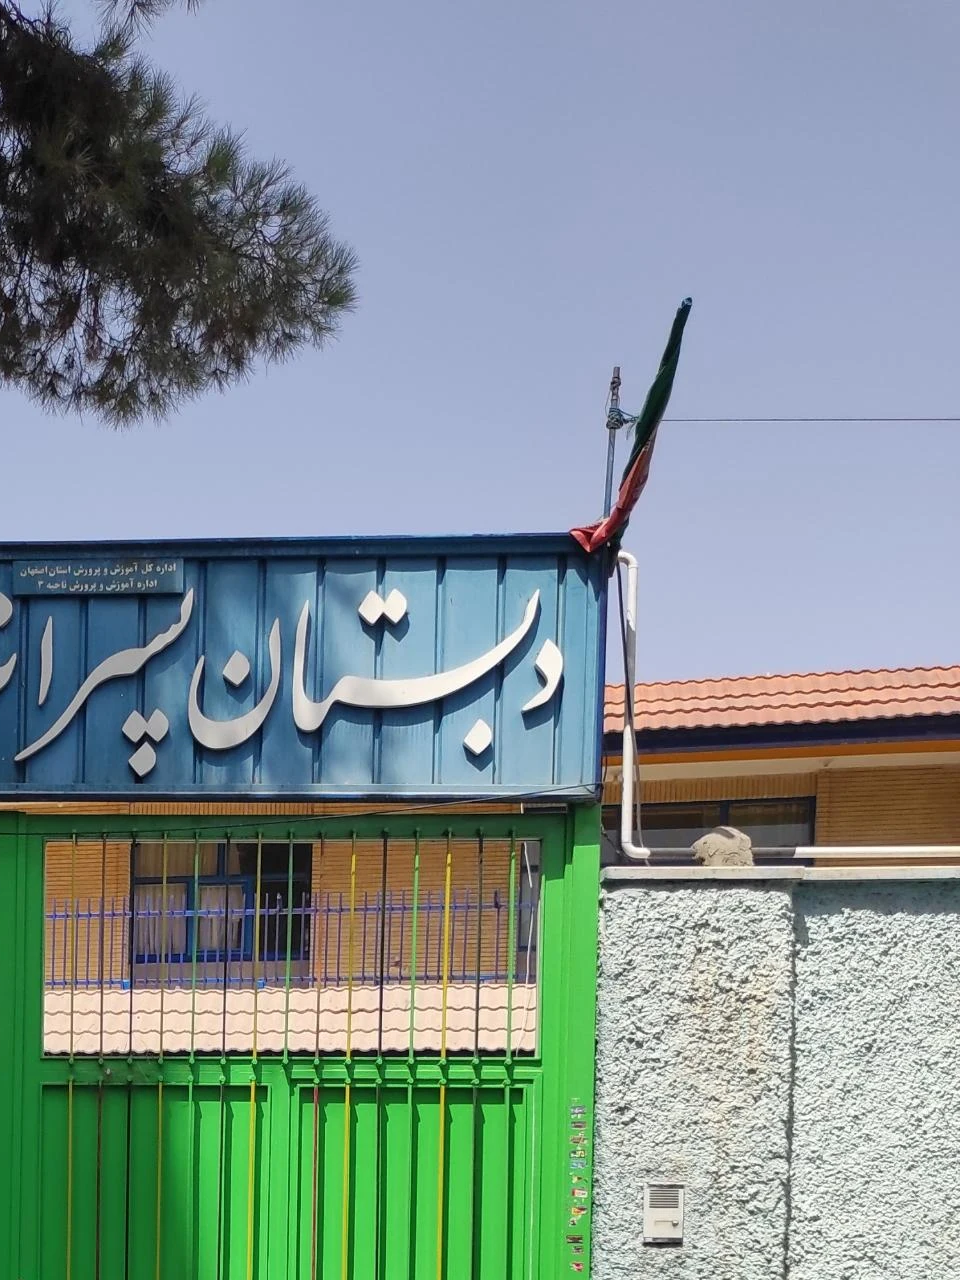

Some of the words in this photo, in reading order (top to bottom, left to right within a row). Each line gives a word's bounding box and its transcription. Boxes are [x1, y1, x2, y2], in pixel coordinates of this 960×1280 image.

[20, 565, 48, 577] اصفهان
[49, 565, 71, 577] استان
[74, 564, 101, 577] پرورش
[110, 562, 138, 576] آموزش
[142, 563, 154, 574] کل
[156, 562, 176, 574] اداره
[46, 580, 67, 591] ناحیه
[69, 580, 97, 592] پرورش
[105, 577, 134, 592] آموزش
[137, 578, 158, 591] اداره
[188, 588, 564, 756] دبستان
